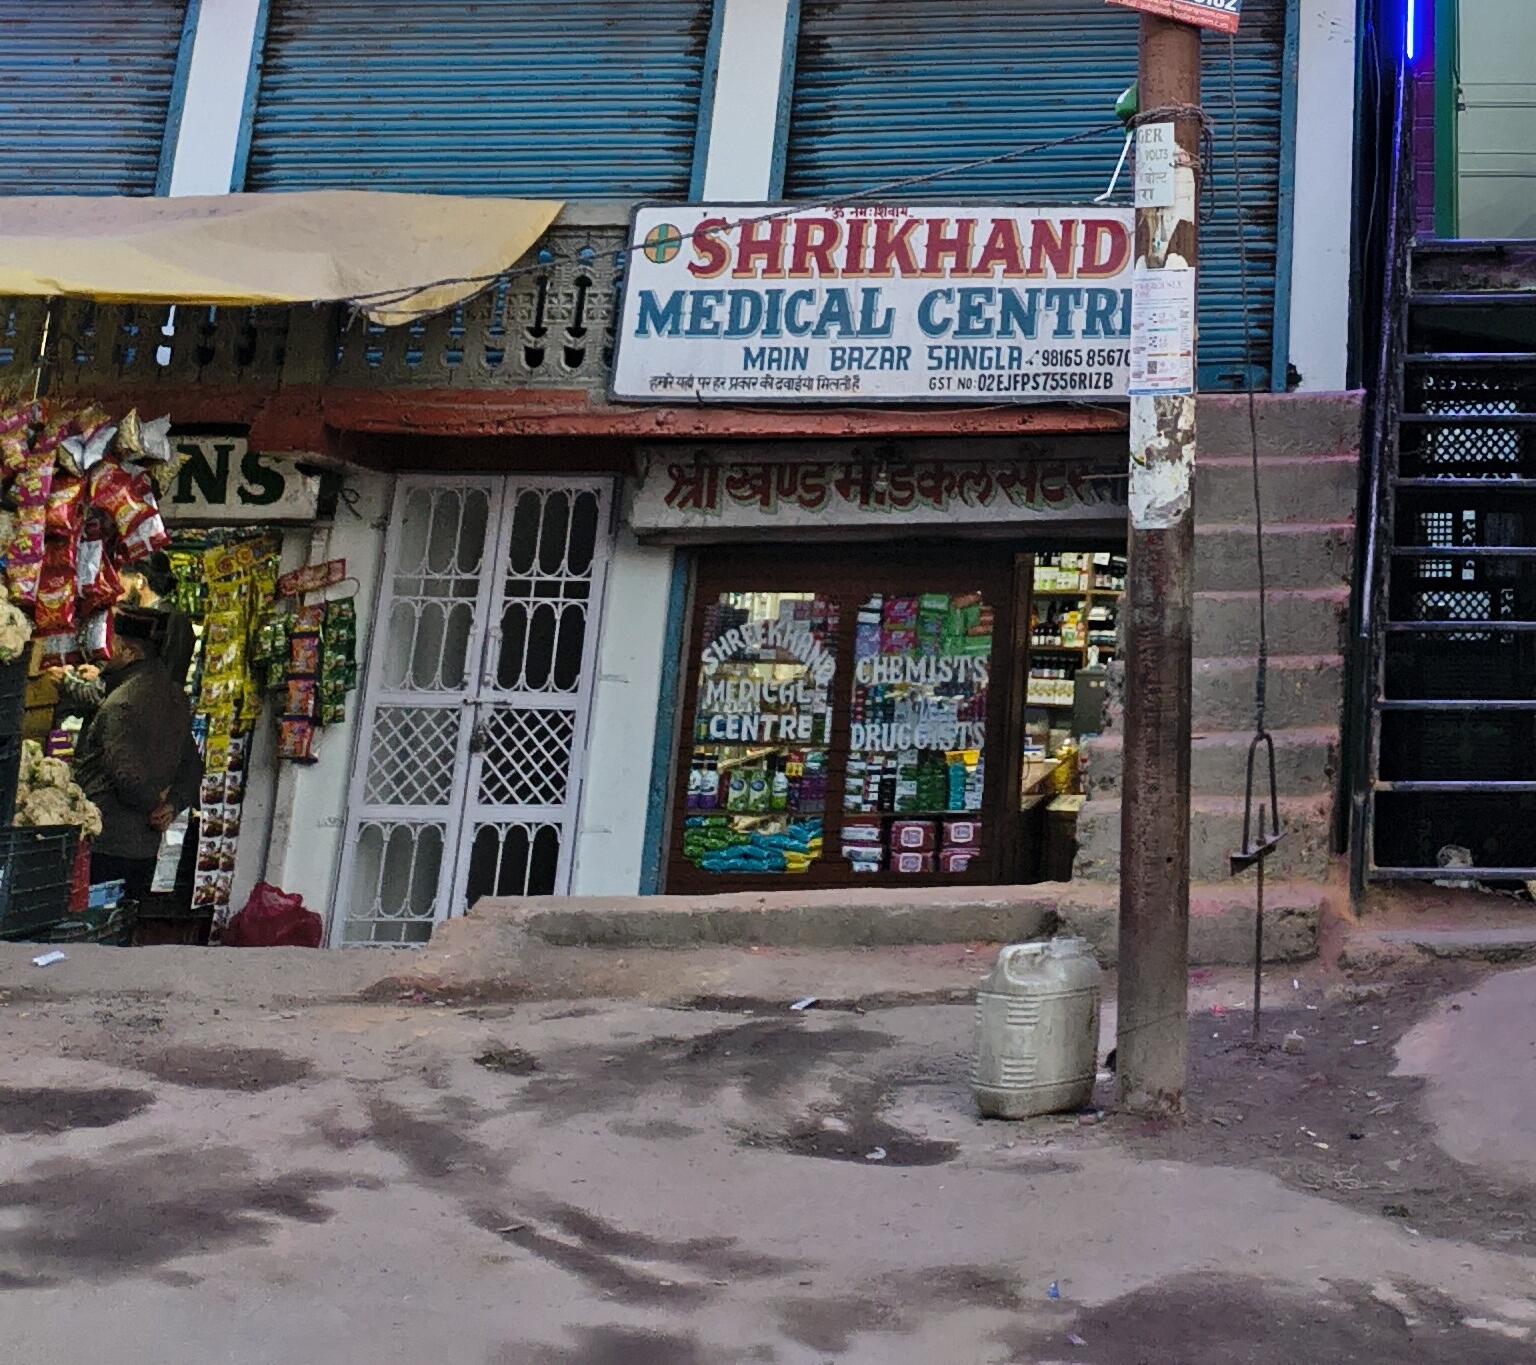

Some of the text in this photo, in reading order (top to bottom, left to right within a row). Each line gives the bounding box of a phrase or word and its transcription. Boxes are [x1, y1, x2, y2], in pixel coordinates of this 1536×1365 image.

[687, 216, 1132, 279] SHRIKHAND
[634, 287, 897, 340] MEDICAL
[743, 346, 809, 371] MAIN
[830, 345, 912, 371] BAZAR
[927, 345, 1023, 371] SANGLA
[699, 374, 712, 390] पर
[713, 374, 728, 392] हर
[928, 376, 951, 390] GST
[855, 655, 990, 684] CHEMISTS
[706, 679, 812, 703] MEDICAL
[709, 714, 813, 742] CENTRE
